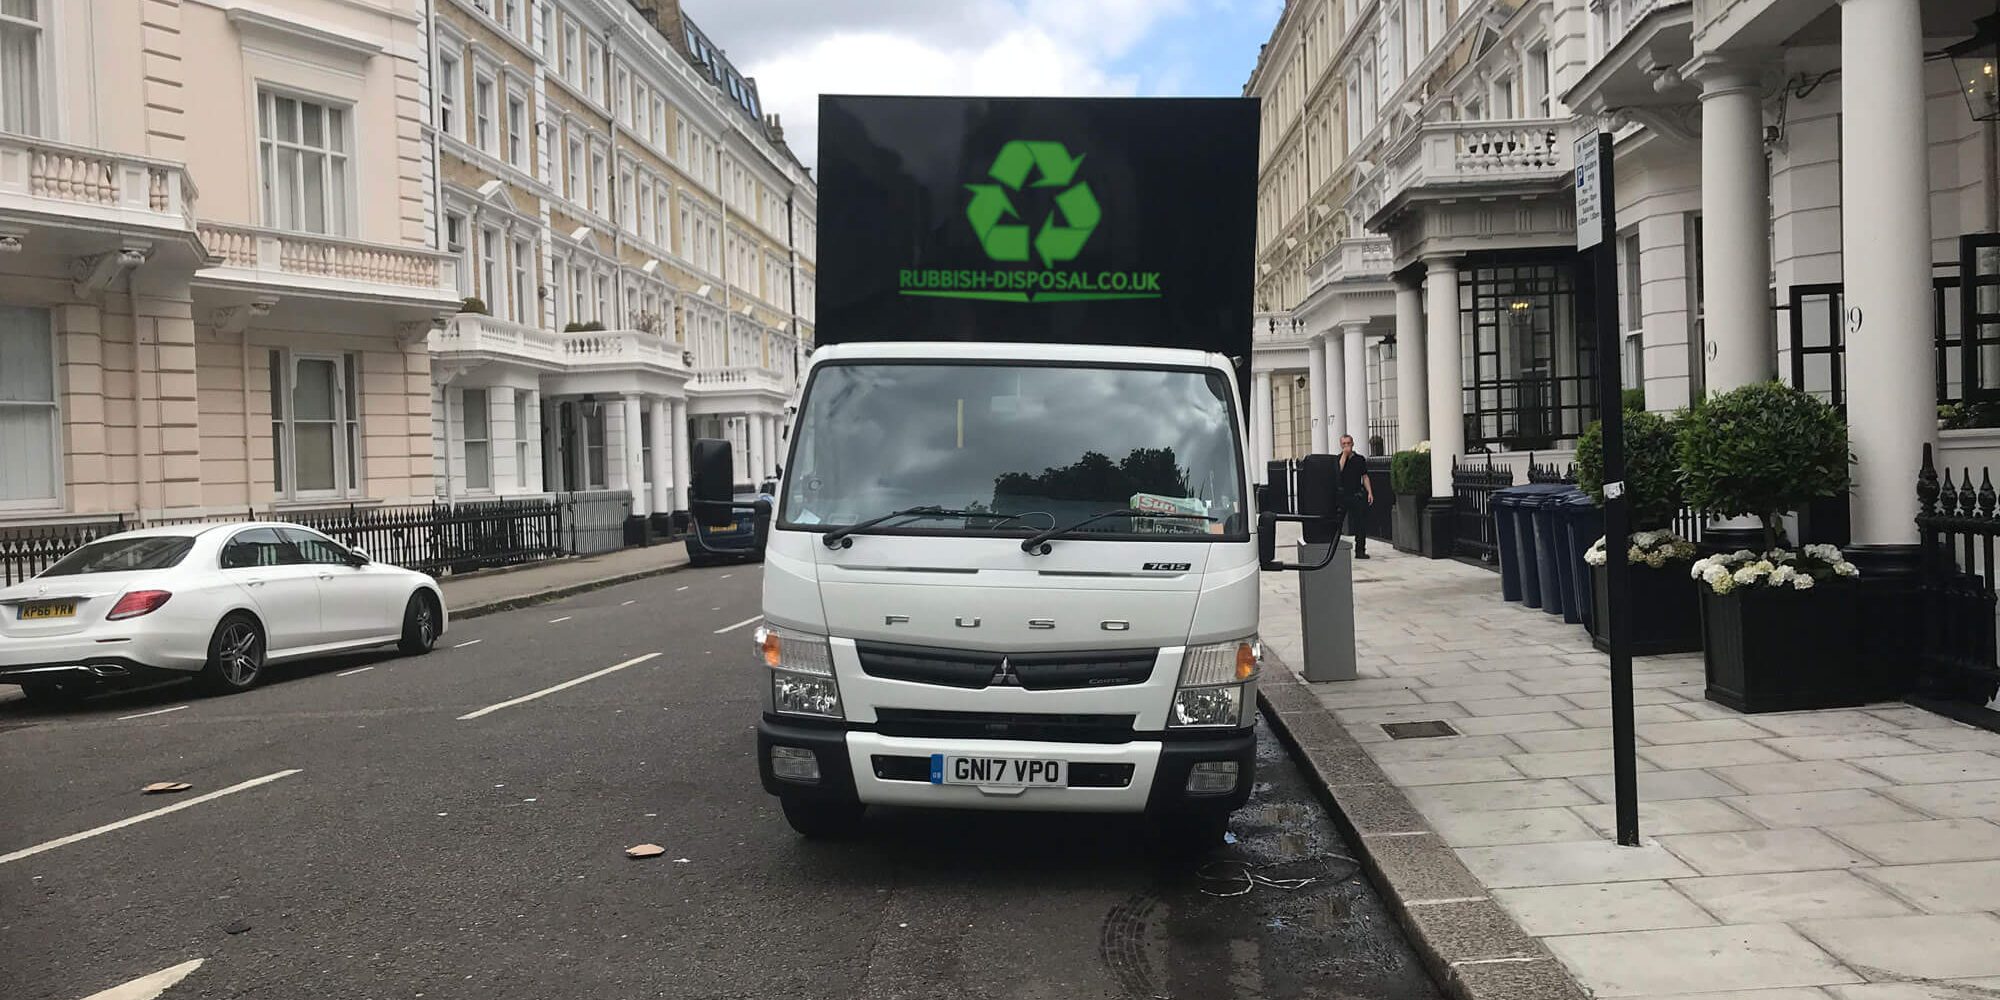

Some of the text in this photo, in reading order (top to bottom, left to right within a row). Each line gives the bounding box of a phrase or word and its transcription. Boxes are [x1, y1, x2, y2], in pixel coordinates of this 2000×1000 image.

[899, 269, 1160, 290] RUBBISH-DISPOSAL.CO.UK
[1846, 306, 1863, 333] 9
[885, 615, 1130, 631] FUSO
[955, 757, 1059, 783] GN17 VPO
